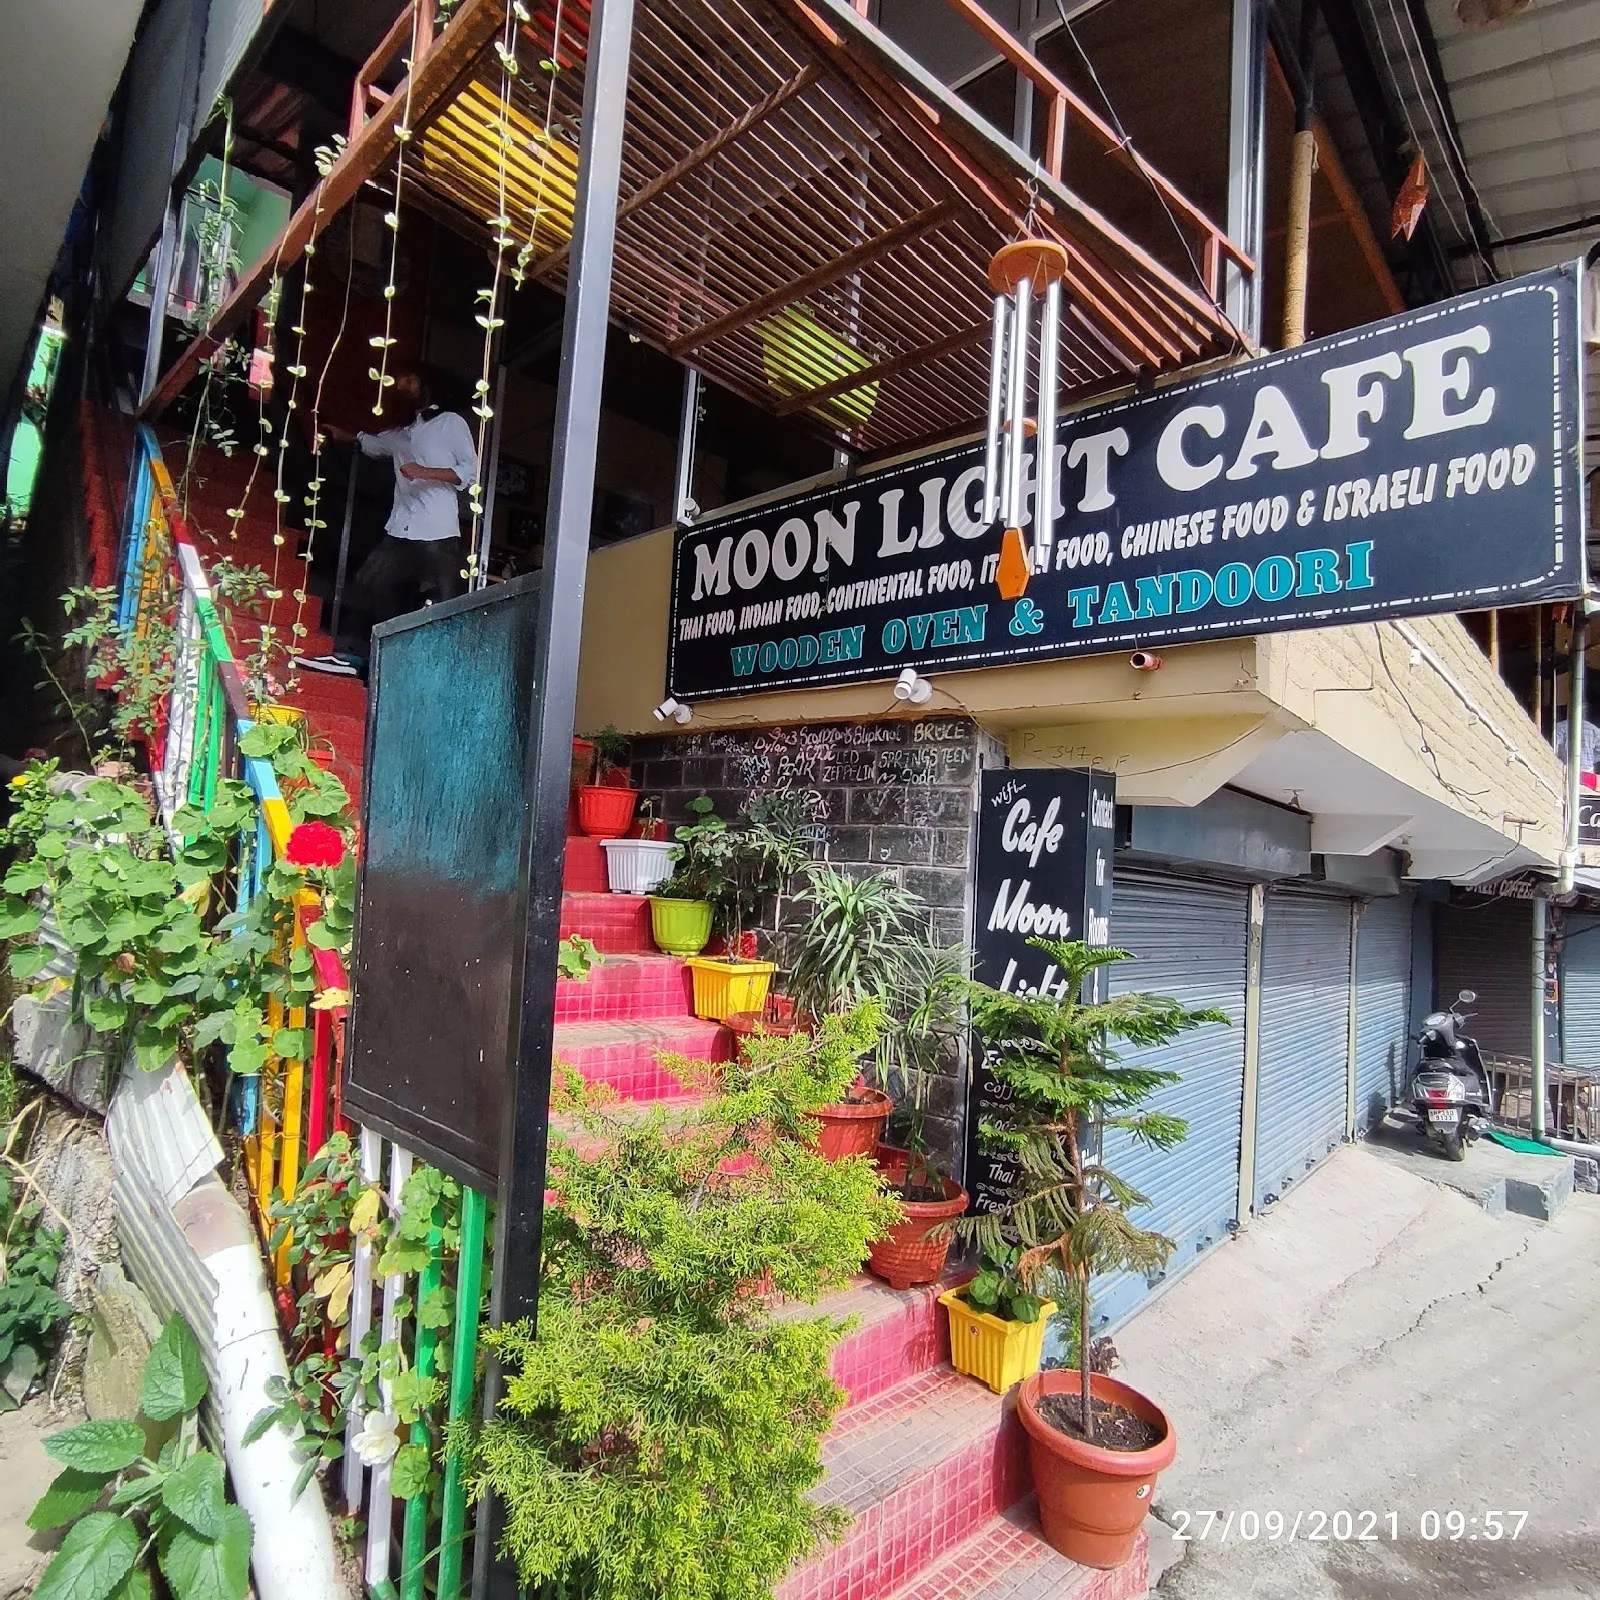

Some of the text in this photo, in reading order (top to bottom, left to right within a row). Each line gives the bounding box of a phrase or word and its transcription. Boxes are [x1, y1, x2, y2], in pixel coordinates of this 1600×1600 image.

[691, 501, 861, 601] MOON
[1157, 325, 1495, 491] CAFE
[679, 615, 704, 642] THAI
[705, 609, 737, 635] FOOD,
[739, 599, 784, 630] INDIAN
[785, 591, 822, 620] FOOD,
[827, 569, 923, 614] CONTINENTAL
[927, 559, 975, 597] FOOD,
[1056, 531, 1113, 571] FOOD,
[1121, 509, 1217, 559] CHINESE
[1222, 496, 1289, 540] FOOD
[1296, 490, 1315, 527] &
[1323, 463, 1437, 522] ISRAELI
[1446, 443, 1536, 498] FOOD
[730, 540, 1374, 676] WOODEN OVEN & TANDOORI
[1002, 796, 1064, 868] Cafe
[1091, 788, 1114, 829] Contact
[1096, 849, 1106, 887] for
[988, 878, 1071, 937] Moon
[1088, 908, 1108, 946] Rooms
[988, 1163, 1016, 1184] Thai
